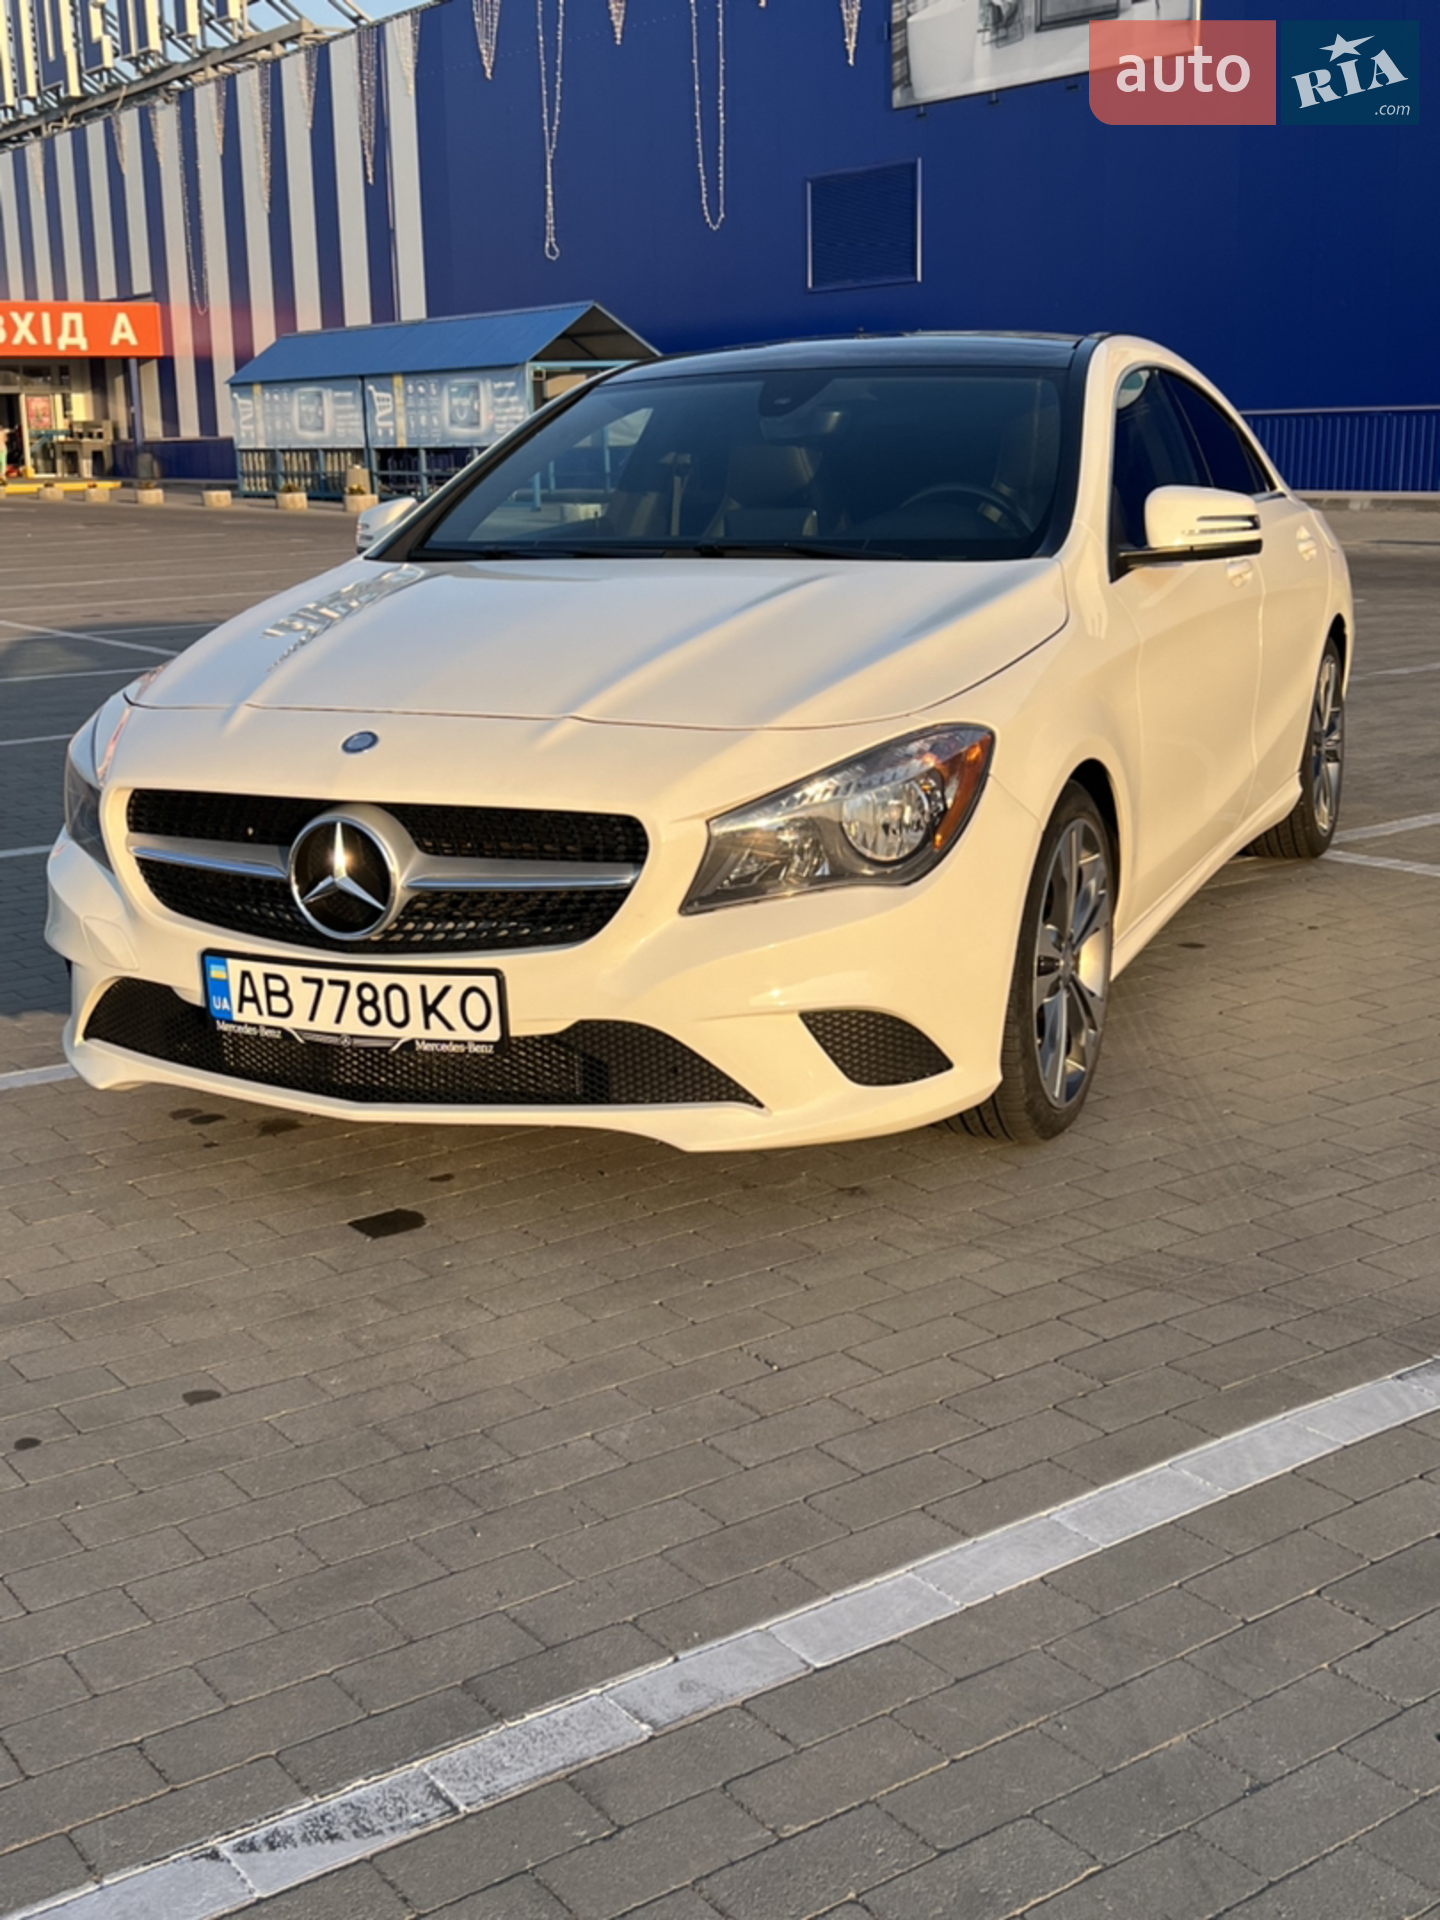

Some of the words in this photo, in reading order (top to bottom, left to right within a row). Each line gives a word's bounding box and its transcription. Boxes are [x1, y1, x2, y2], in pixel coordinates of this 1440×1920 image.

[110, 312, 138, 346] А
[212, 995, 231, 1011] UA
[238, 970, 294, 1019] AB
[301, 976, 411, 1029] 7780
[419, 984, 492, 1033] KO
[216, 1019, 283, 1039] Mercedes-Benz
[415, 1039, 495, 1054] Mercedes-Benz
